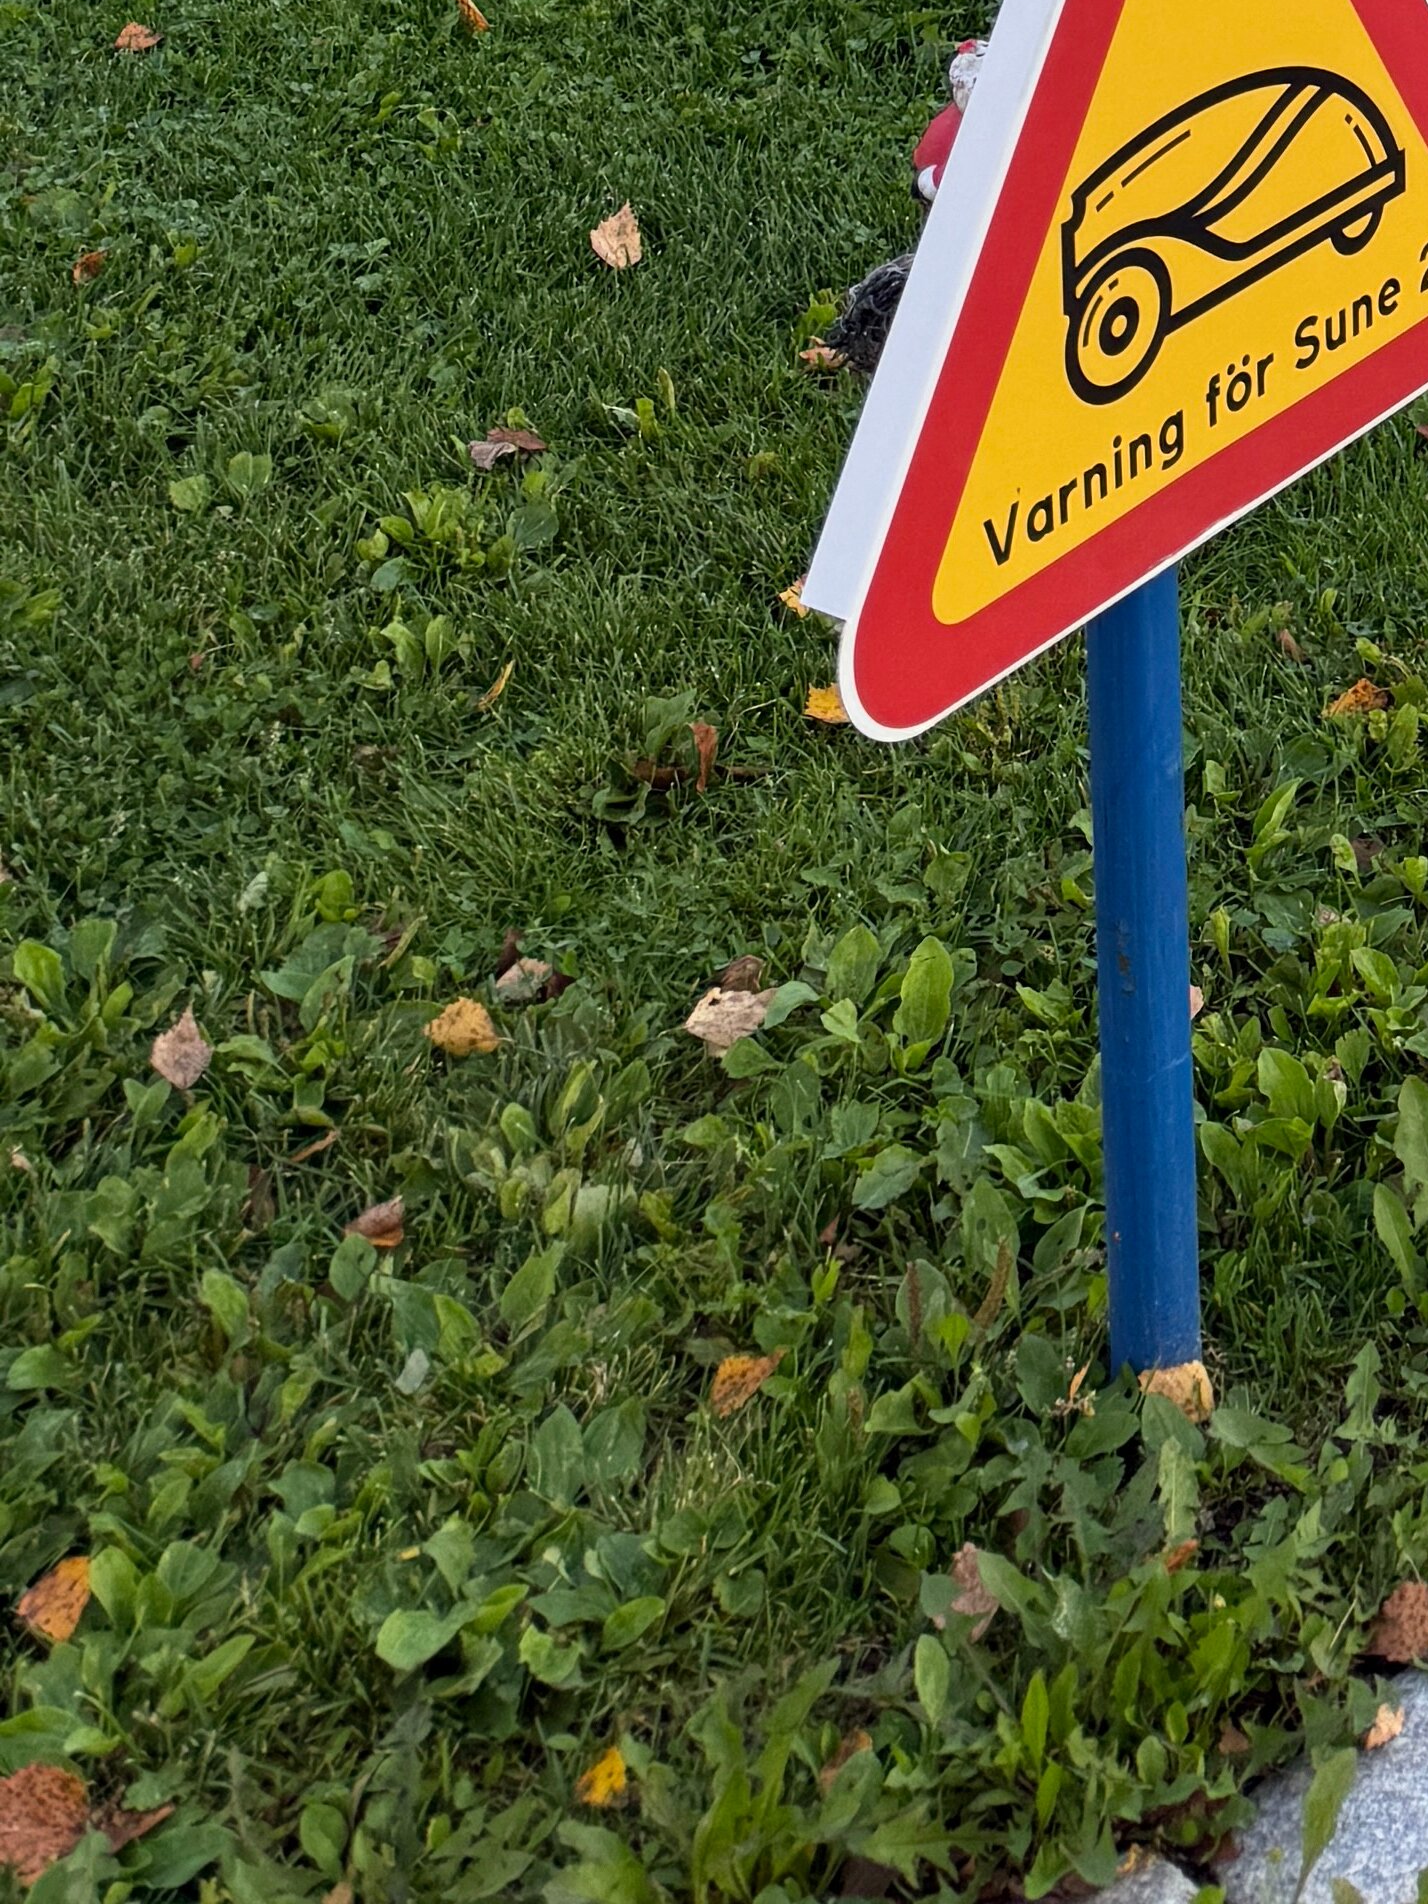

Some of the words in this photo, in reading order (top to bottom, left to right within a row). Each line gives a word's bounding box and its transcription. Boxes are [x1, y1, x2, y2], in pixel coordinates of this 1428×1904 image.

[983, 409, 1184, 566] Varning
[1206, 352, 1274, 427] för
[1294, 277, 1401, 369] Sune
